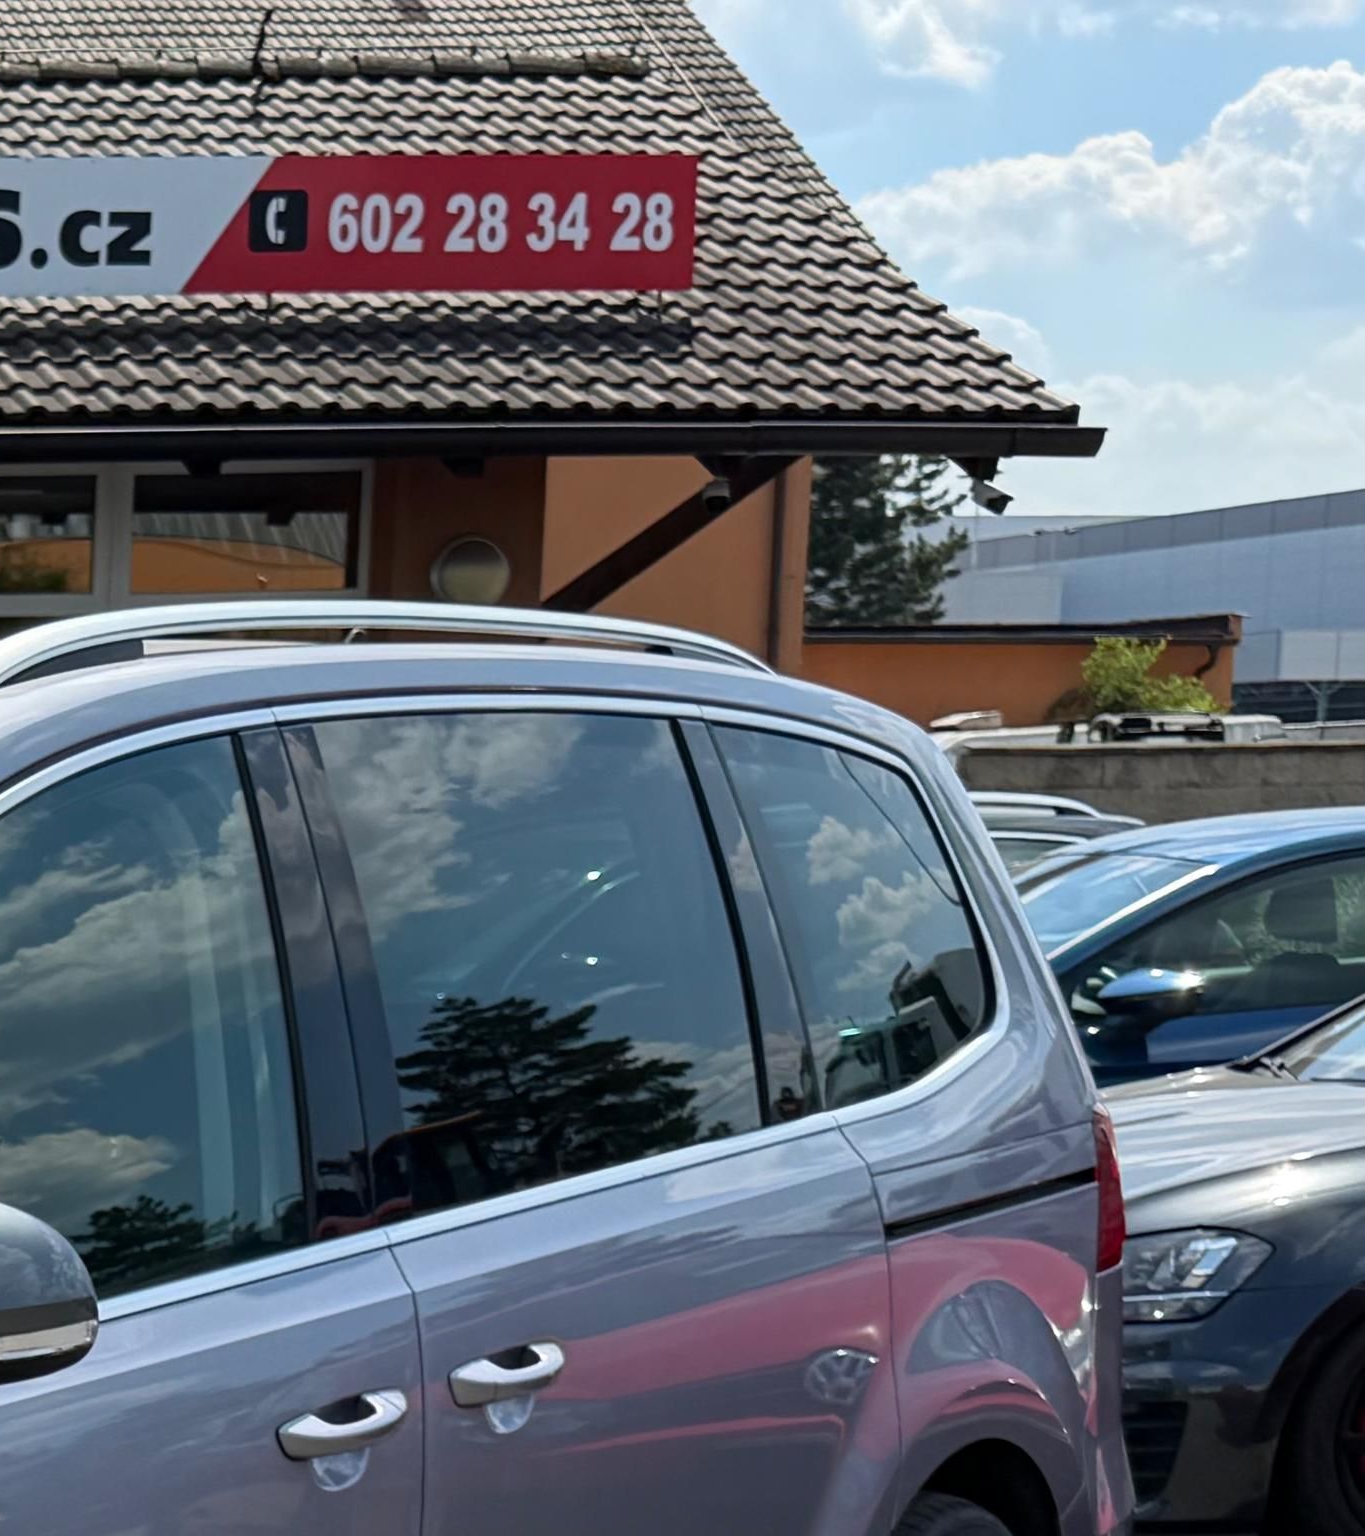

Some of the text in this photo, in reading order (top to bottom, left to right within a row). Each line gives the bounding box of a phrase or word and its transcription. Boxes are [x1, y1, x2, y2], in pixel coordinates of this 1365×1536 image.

[327, 192, 672, 253] 602 28 34 28
